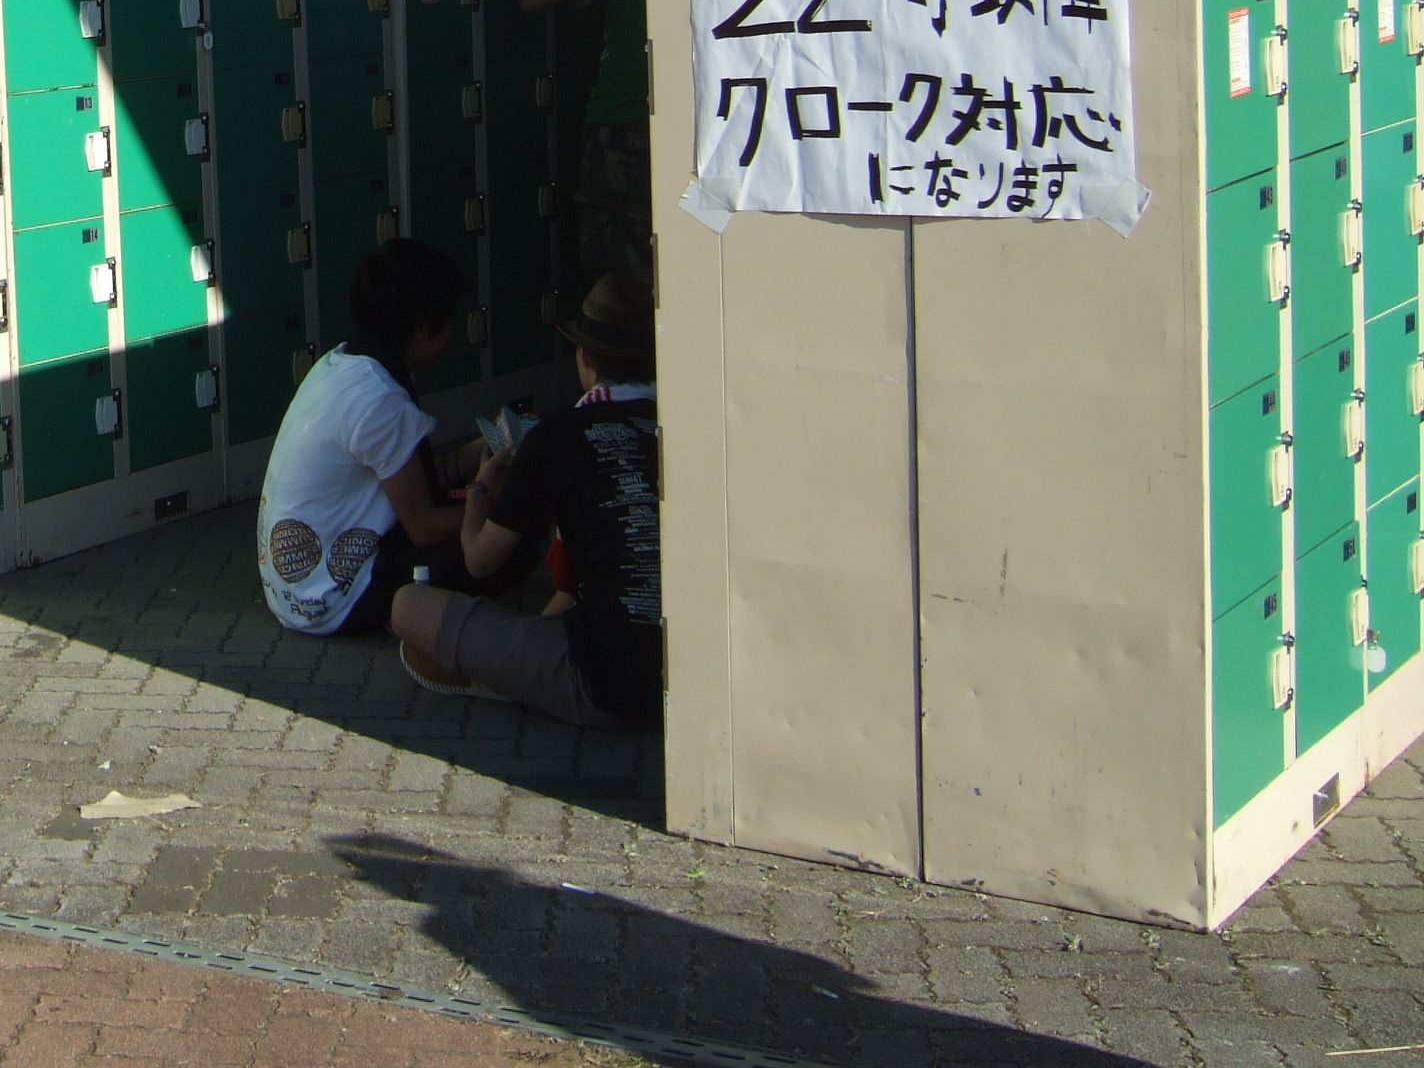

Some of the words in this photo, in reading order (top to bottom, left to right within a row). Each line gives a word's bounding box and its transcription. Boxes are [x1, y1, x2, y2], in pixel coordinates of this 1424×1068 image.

[716, 73, 1123, 167] クローク対応
[866, 150, 1079, 220] になります
